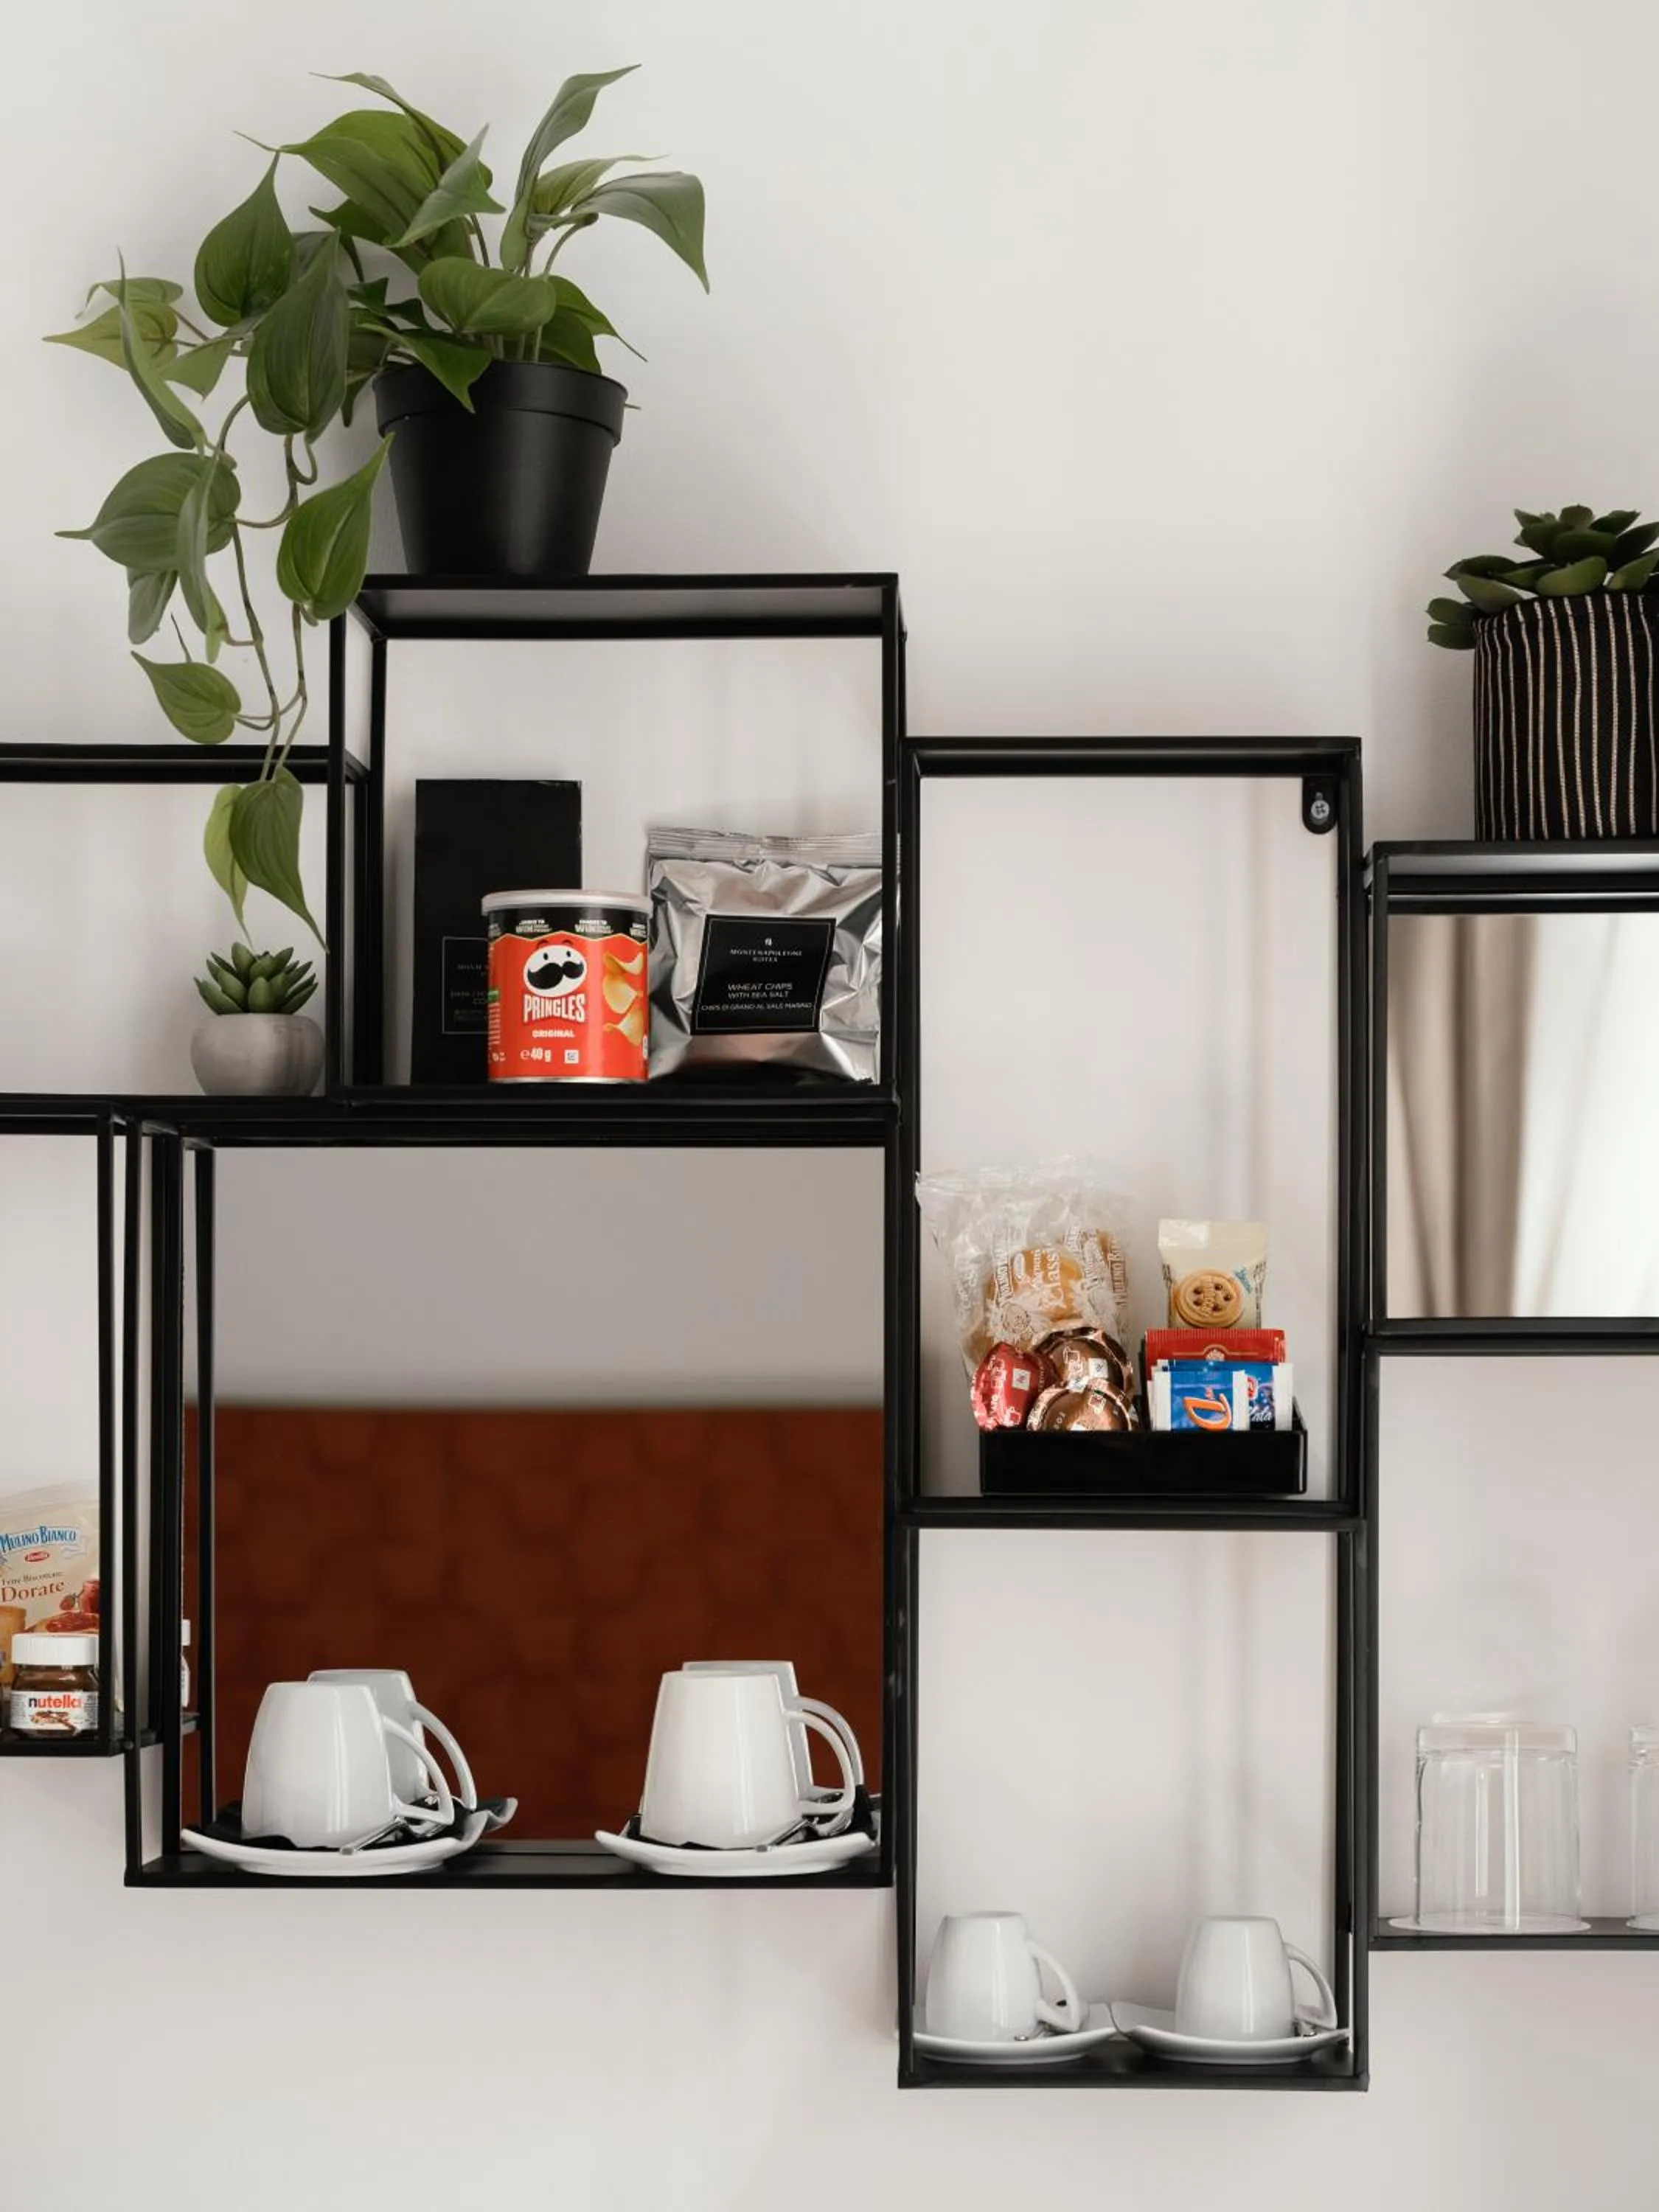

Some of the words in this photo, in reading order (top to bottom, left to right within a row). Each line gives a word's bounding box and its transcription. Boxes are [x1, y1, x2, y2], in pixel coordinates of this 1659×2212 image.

[728, 983, 763, 991] WHEAT
[765, 982, 793, 990] CHIPS
[524, 993, 585, 1023] PRINGLES
[532, 1029, 575, 1038] ORIGINAL
[0, 1533, 38, 1552] MULINO
[39, 1526, 77, 1543] BIANCO
[1, 1581, 65, 1602] Dorate
[29, 1694, 82, 1708] nutella
